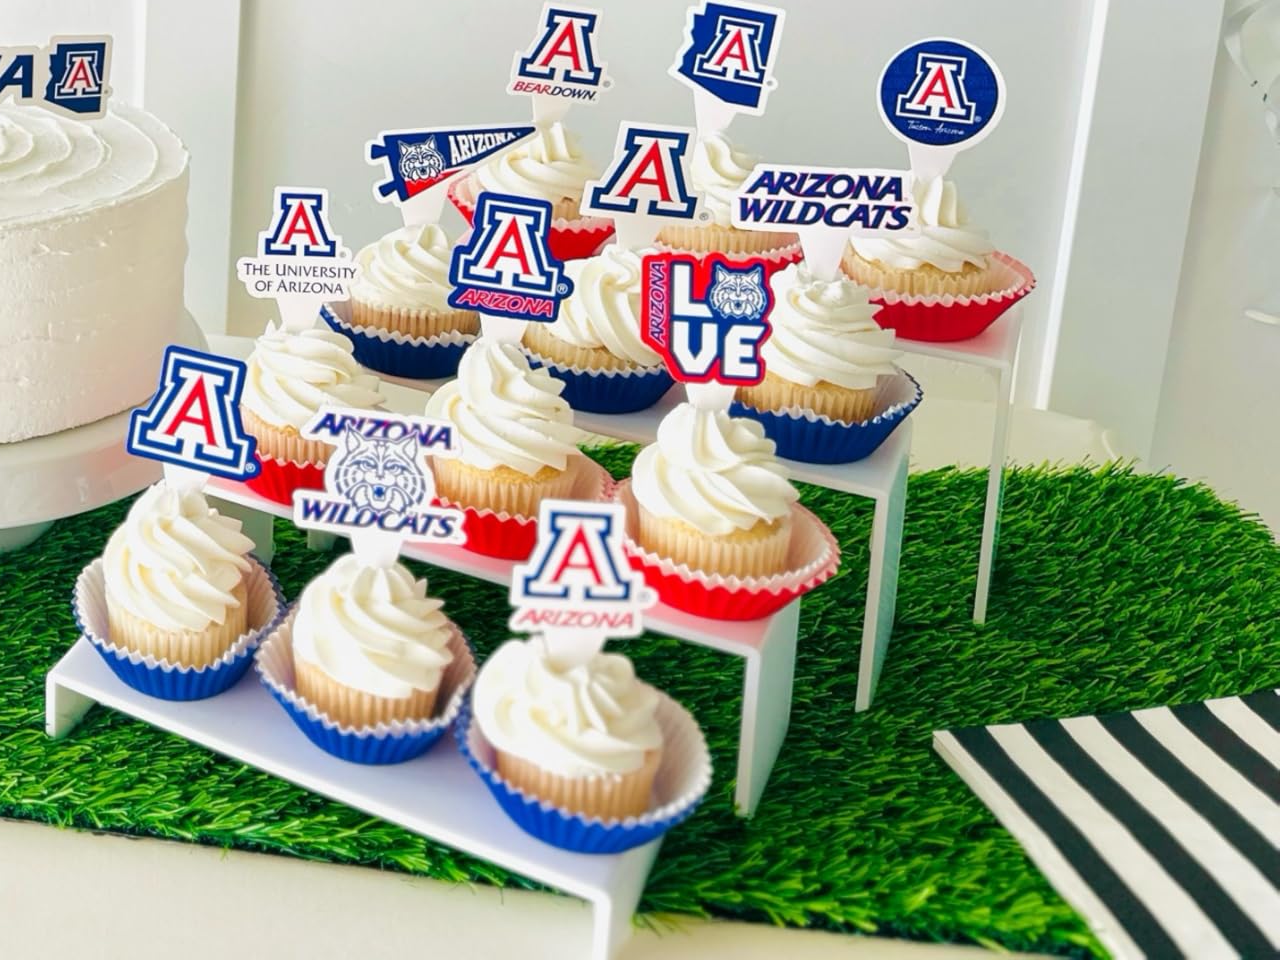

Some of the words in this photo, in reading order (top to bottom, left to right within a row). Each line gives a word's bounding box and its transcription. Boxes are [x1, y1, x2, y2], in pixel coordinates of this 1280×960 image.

[518, 8, 602, 86] A
[692, 15, 768, 89] A
[53, 50, 105, 100] A
[895, 52, 976, 124] A
[449, 131, 518, 166] ARIZONA
[589, 128, 699, 220] A
[745, 170, 904, 203] ARIZONA
[264, 193, 337, 258] A
[738, 197, 912, 231] WILDCATS
[243, 262, 271, 277] THE
[275, 262, 358, 280] UNIVERSITY
[458, 198, 560, 297] A
[254, 279, 274, 293] OF
[276, 279, 344, 295] ARIZONA
[457, 288, 555, 318] ARIZONA
[649, 260, 667, 345] ARIZONA
[131, 350, 251, 476] A
[310, 412, 453, 451] ARIZONA
[301, 497, 458, 538] WILDCATS
[522, 510, 631, 601] A
[516, 608, 635, 629] ARIZONA
